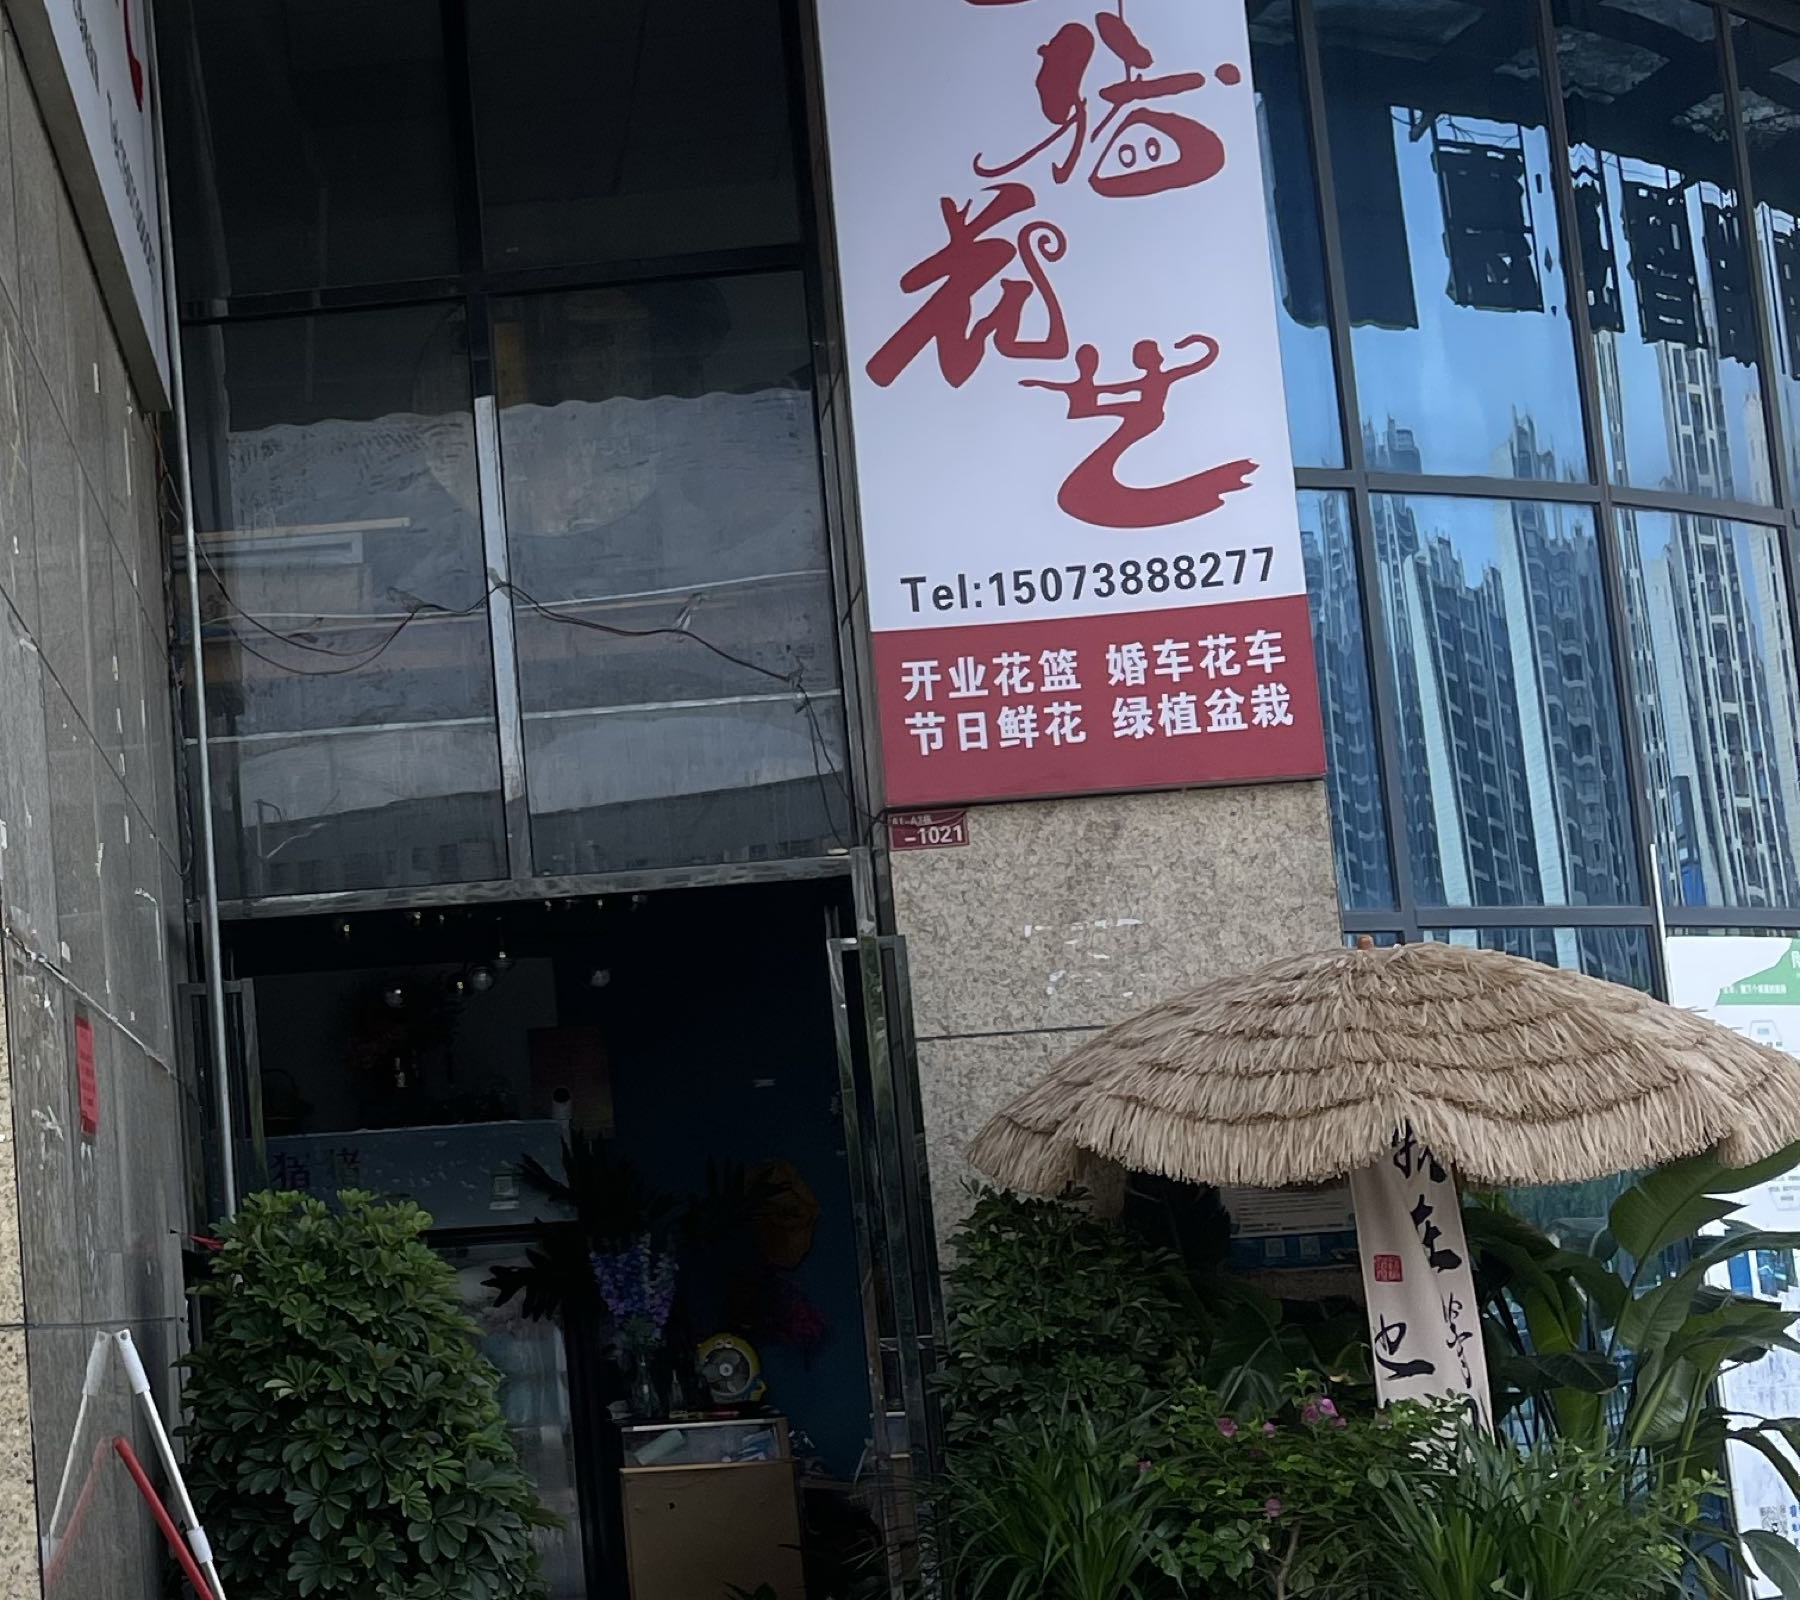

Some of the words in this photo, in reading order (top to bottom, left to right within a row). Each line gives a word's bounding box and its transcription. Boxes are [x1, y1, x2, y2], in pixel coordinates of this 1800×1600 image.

[900, 546, 1275, 613] Tel:15073888277
[902, 649, 1082, 702] 开业花篮
[1105, 629, 1287, 688] 婚车花车
[906, 702, 1088, 756] 节日鲜花
[1112, 682, 1294, 741] 绿植盆栽
